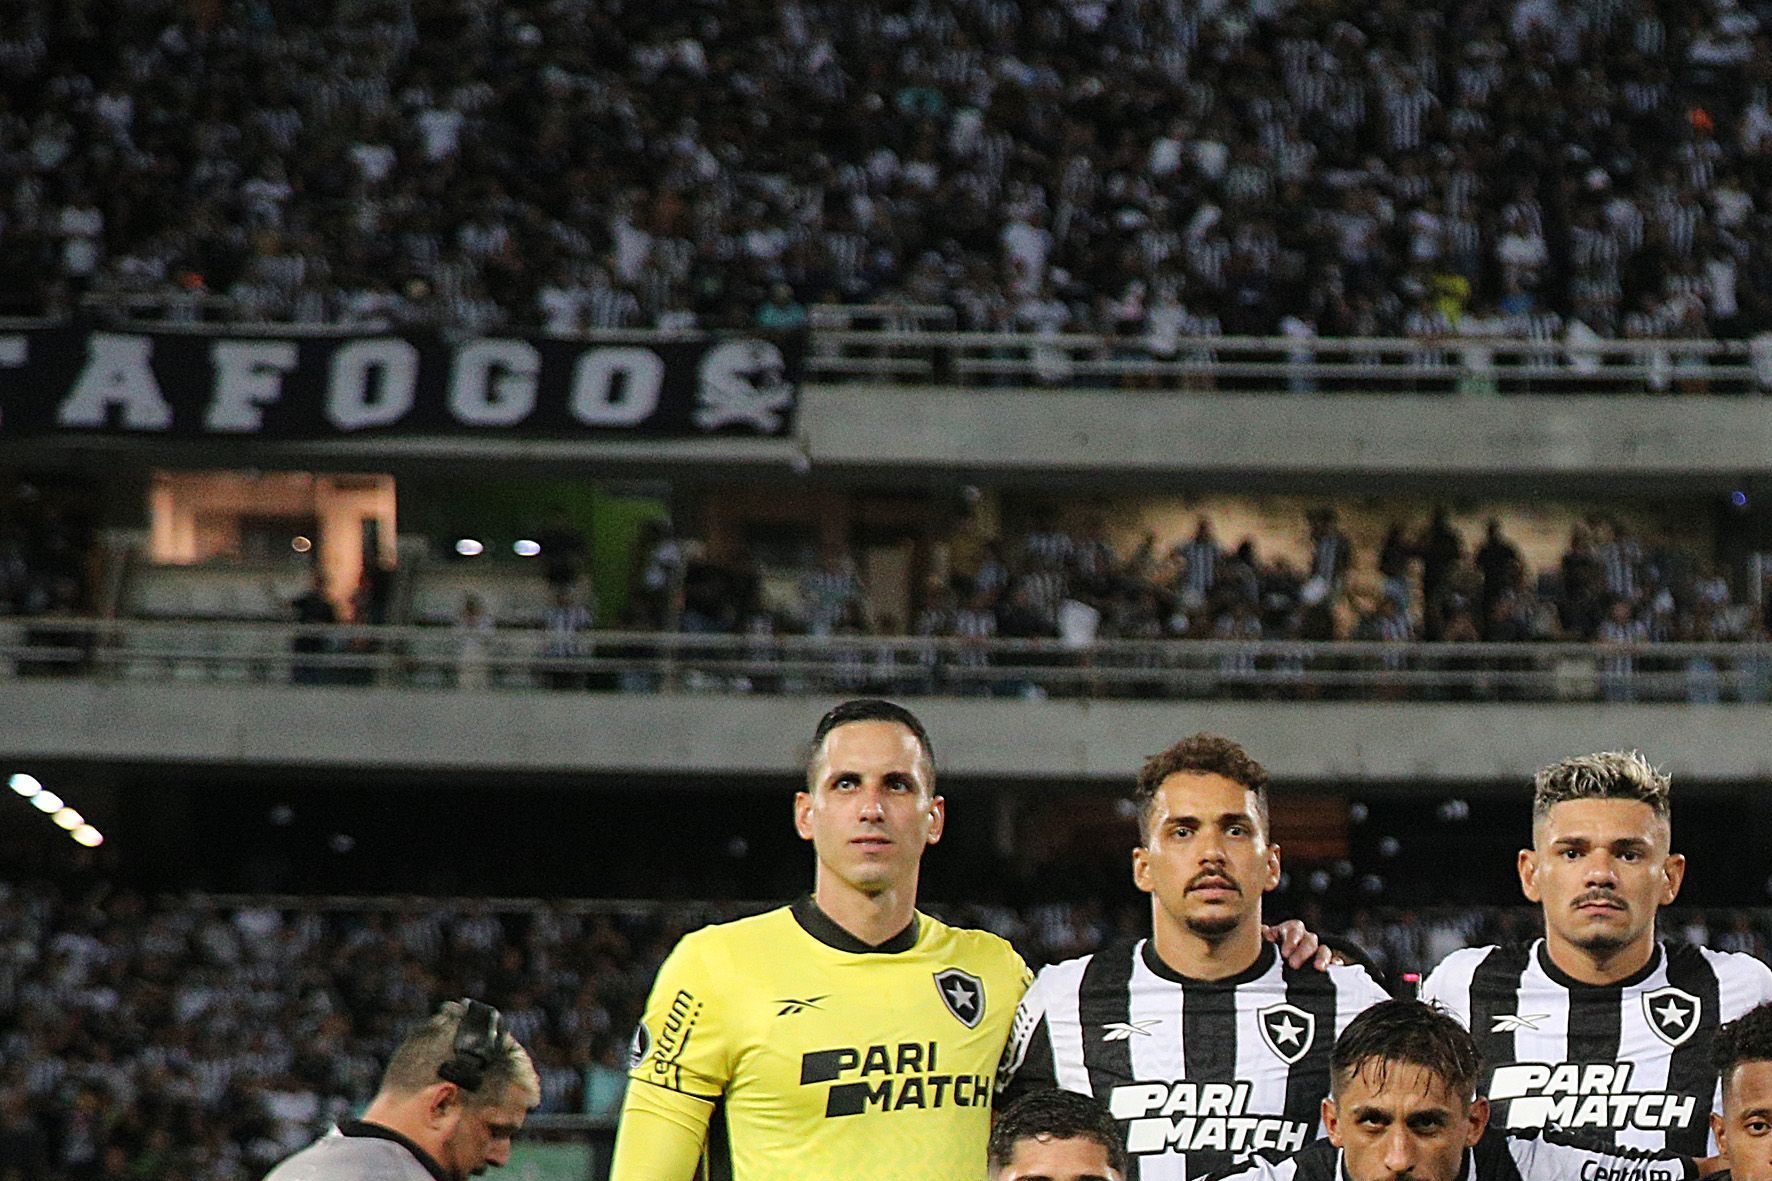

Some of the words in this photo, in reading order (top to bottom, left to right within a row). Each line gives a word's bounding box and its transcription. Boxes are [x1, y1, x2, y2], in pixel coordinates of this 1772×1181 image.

[0, 334, 666, 433] AFOGO
[800, 1041, 938, 1085] PARI
[825, 1074, 990, 1118] MATCH
[1488, 1064, 1631, 1100] PARI
[1110, 1083, 1249, 1120] PARI
[1506, 1094, 1697, 1130] MATCH
[1127, 1117, 1309, 1153] MATCH
